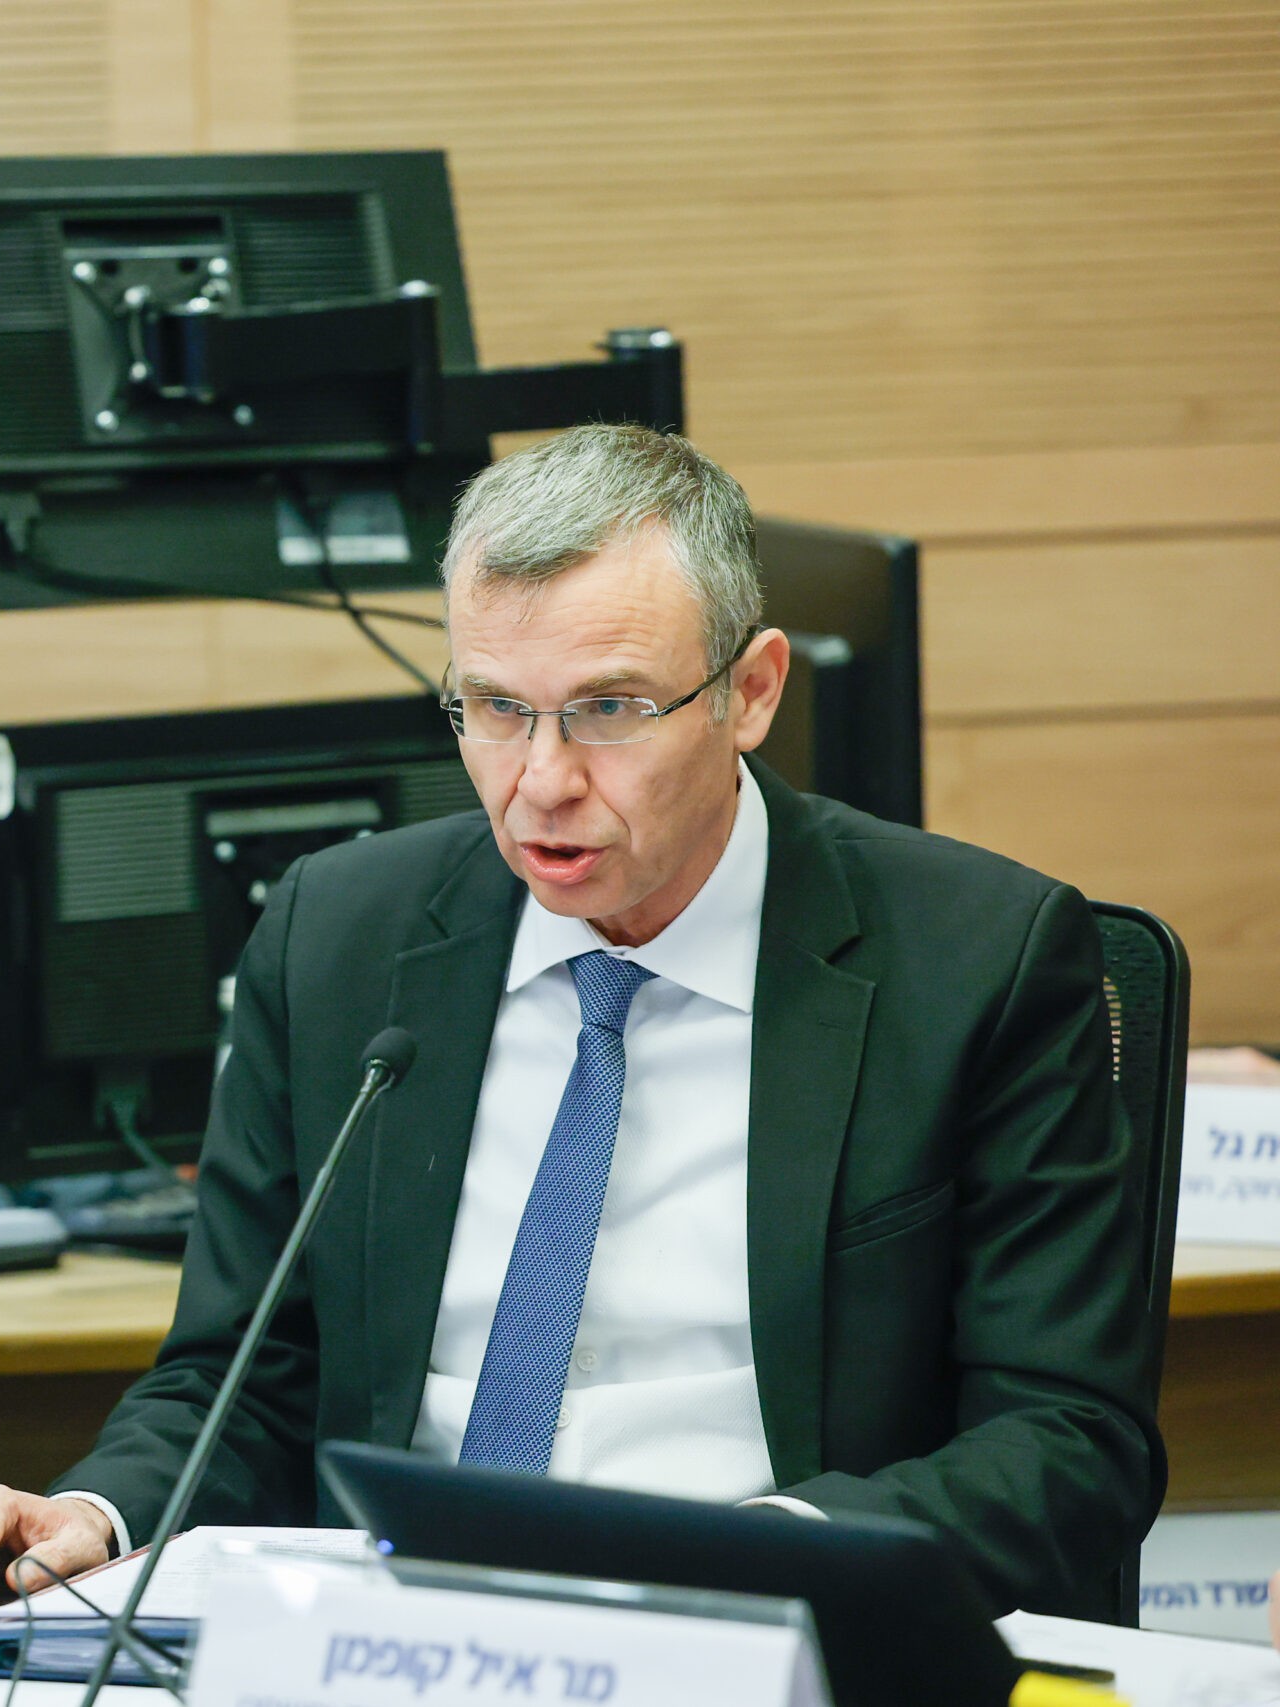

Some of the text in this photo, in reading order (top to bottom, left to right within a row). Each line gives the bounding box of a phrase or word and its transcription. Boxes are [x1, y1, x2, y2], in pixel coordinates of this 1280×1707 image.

[1209, 1126, 1244, 1159] גל
[1206, 1579, 1269, 1607] שרד
[466, 1639, 541, 1693] איל
[556, 1656, 617, 1705] מר
